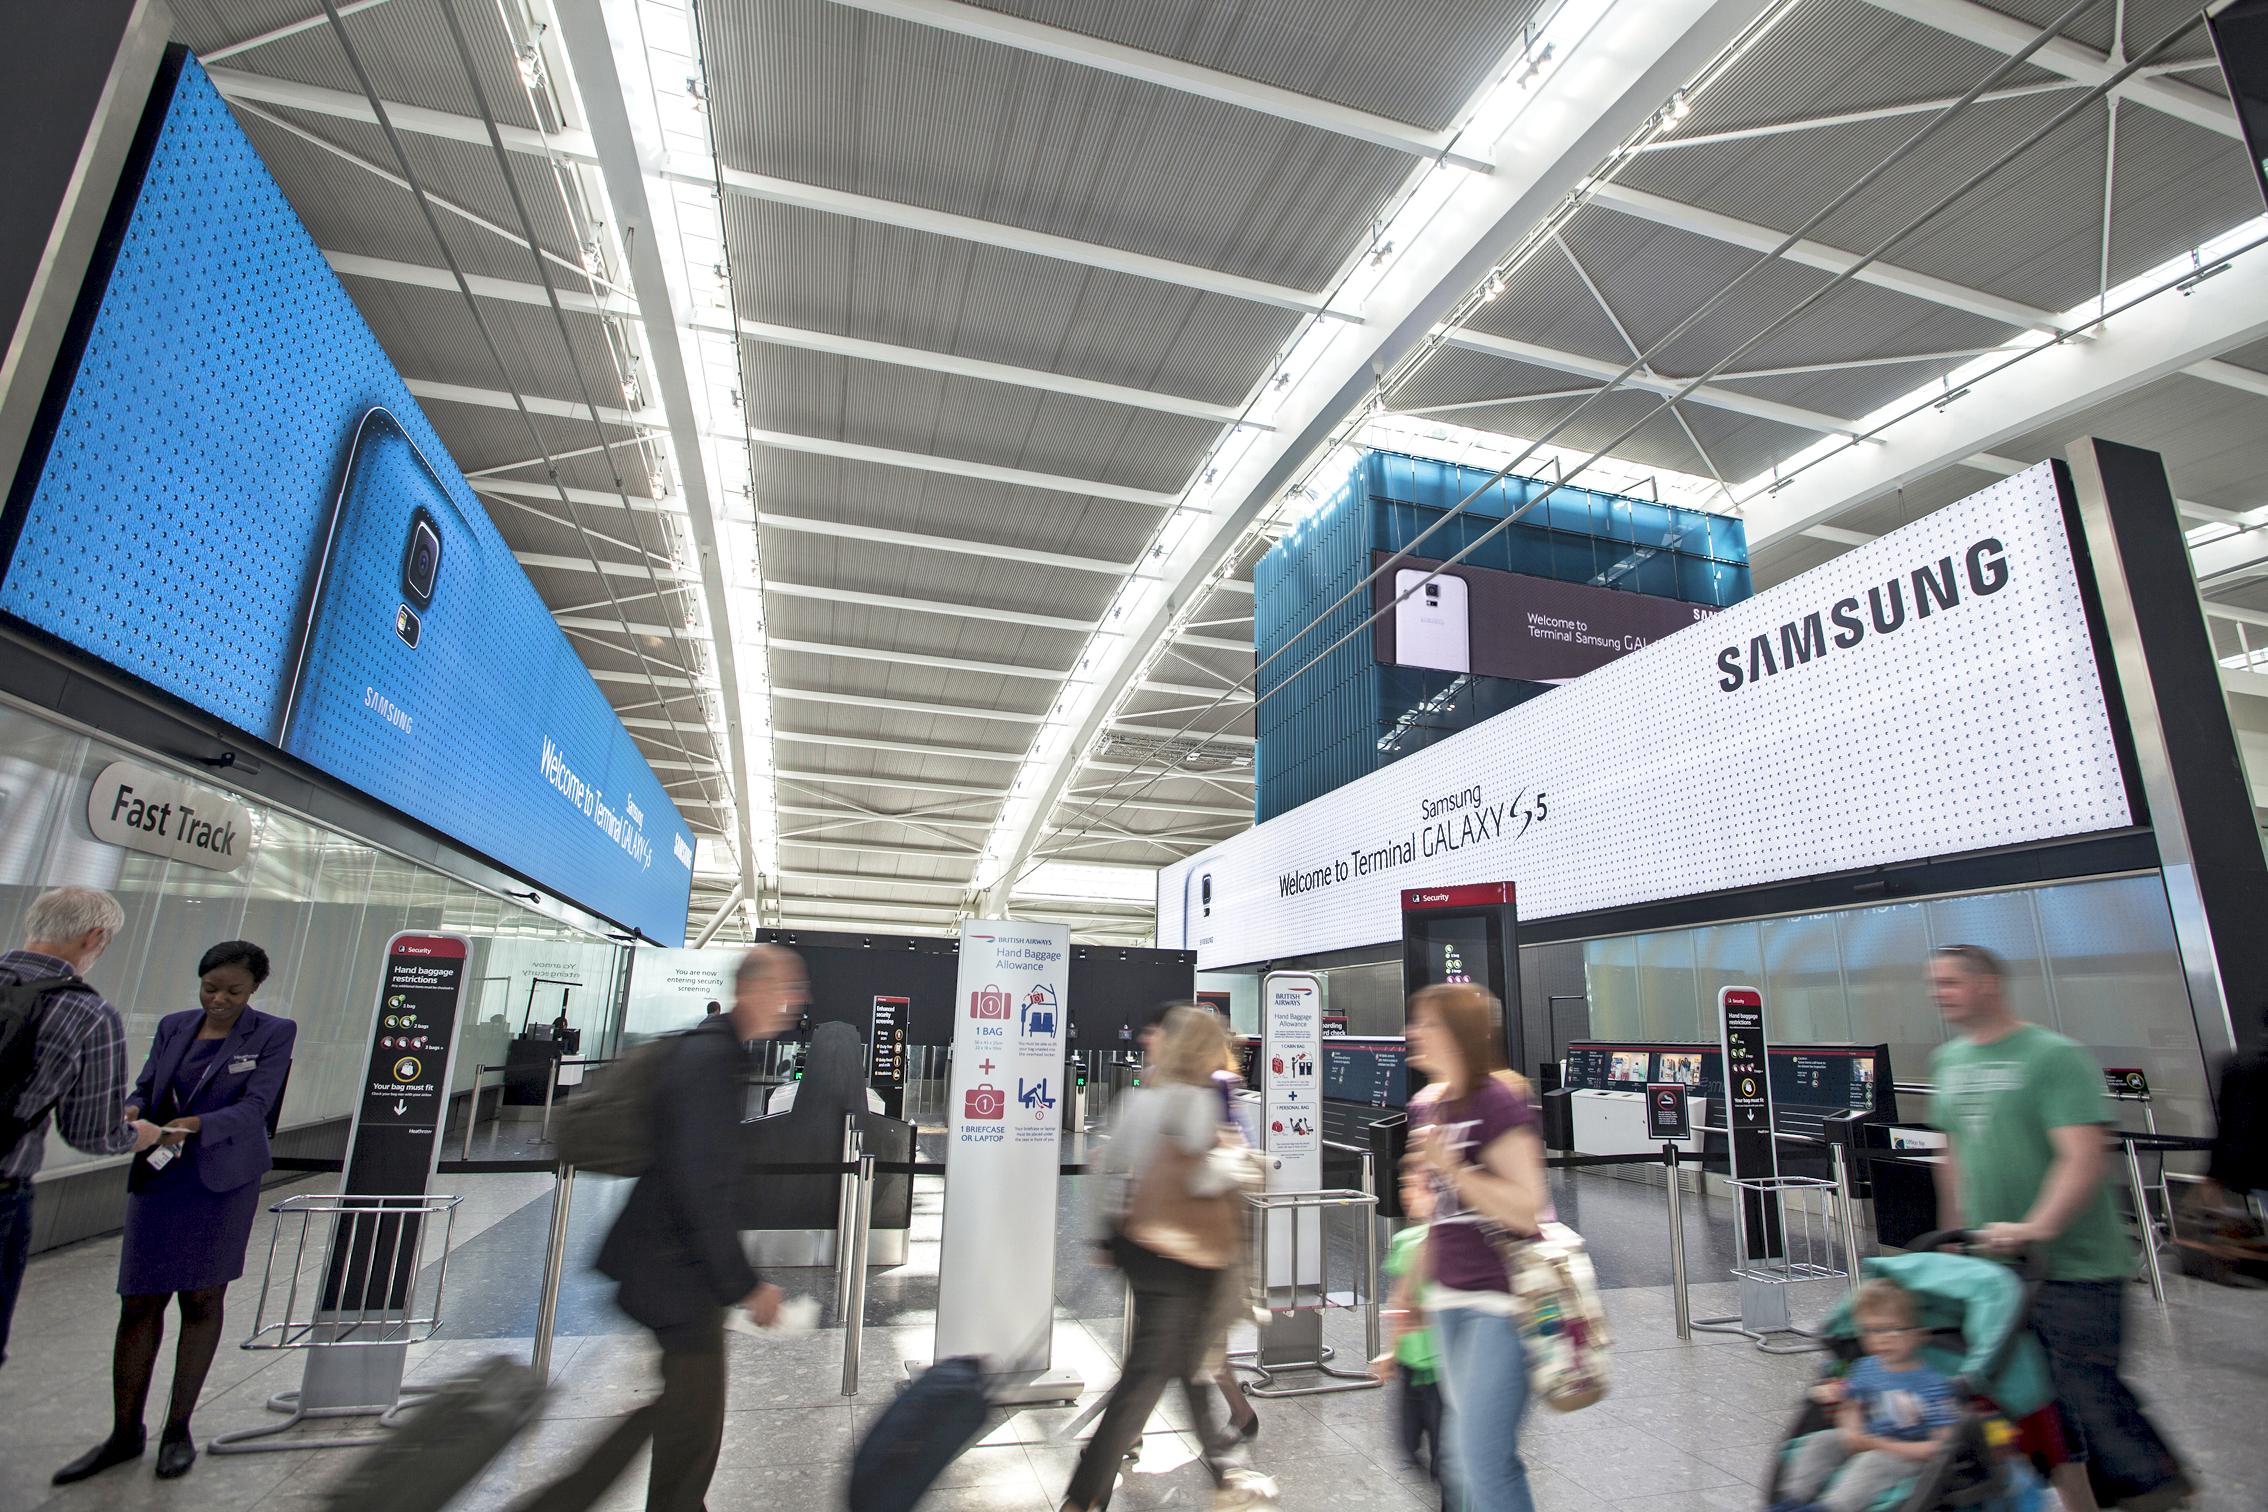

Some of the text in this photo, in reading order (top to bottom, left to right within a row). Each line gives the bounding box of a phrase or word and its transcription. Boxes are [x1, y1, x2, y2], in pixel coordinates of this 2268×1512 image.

[1717, 538, 2009, 692] SAMSUNG
[1527, 612, 1588, 632] Welcome to
[1528, 626, 1648, 651] Terminal Samsung GAL
[364, 686, 413, 735] SAMSUNG
[540, 734, 584, 808] Welcome
[583, 783, 594, 816] to
[594, 790, 623, 844] Terminal
[621, 817, 646, 862] GALAXY
[1422, 785, 1482, 820] Samsung
[626, 793, 644, 831] Samsung
[110, 784, 236, 856] Fast Track
[674, 832, 692, 870] SAMSUNG
[1279, 865, 1332, 898] Welcome
[1335, 859, 1349, 882] to
[1352, 832, 1416, 877] Terminal
[1422, 802, 1504, 858] GALAXY
[1423, 894, 1450, 902] Security
[1025, 938, 1052, 946] AIRWAYS
[408, 946, 432, 954] Security
[997, 948, 1062, 961] Hand Baggage
[996, 960, 1044, 971] Allowance
[394, 966, 454, 977] Hand baggage
[676, 968, 688, 976] You
[392, 976, 438, 984] restrictions
[667, 977, 724, 986] entering security
[988, 1001, 993, 1011] 1
[983, 1027, 1003, 1036] BAG
[391, 1083, 404, 1091] bag
[982, 1099, 987, 1110] 1
